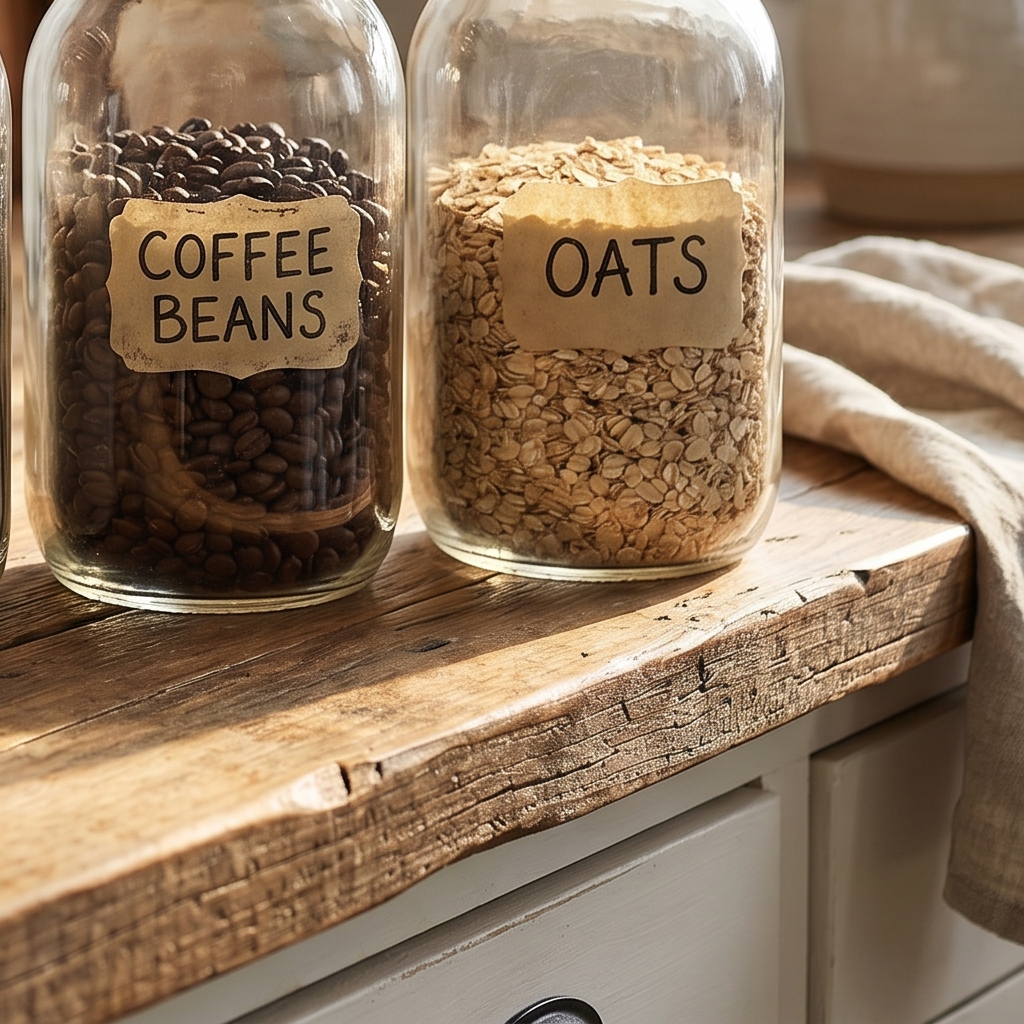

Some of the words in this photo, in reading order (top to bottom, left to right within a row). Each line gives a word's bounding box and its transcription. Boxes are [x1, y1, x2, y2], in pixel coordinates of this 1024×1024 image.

[138, 226, 334, 282] COFFEE
[544, 234, 709, 299] OATS
[153, 289, 327, 345] BEANS
